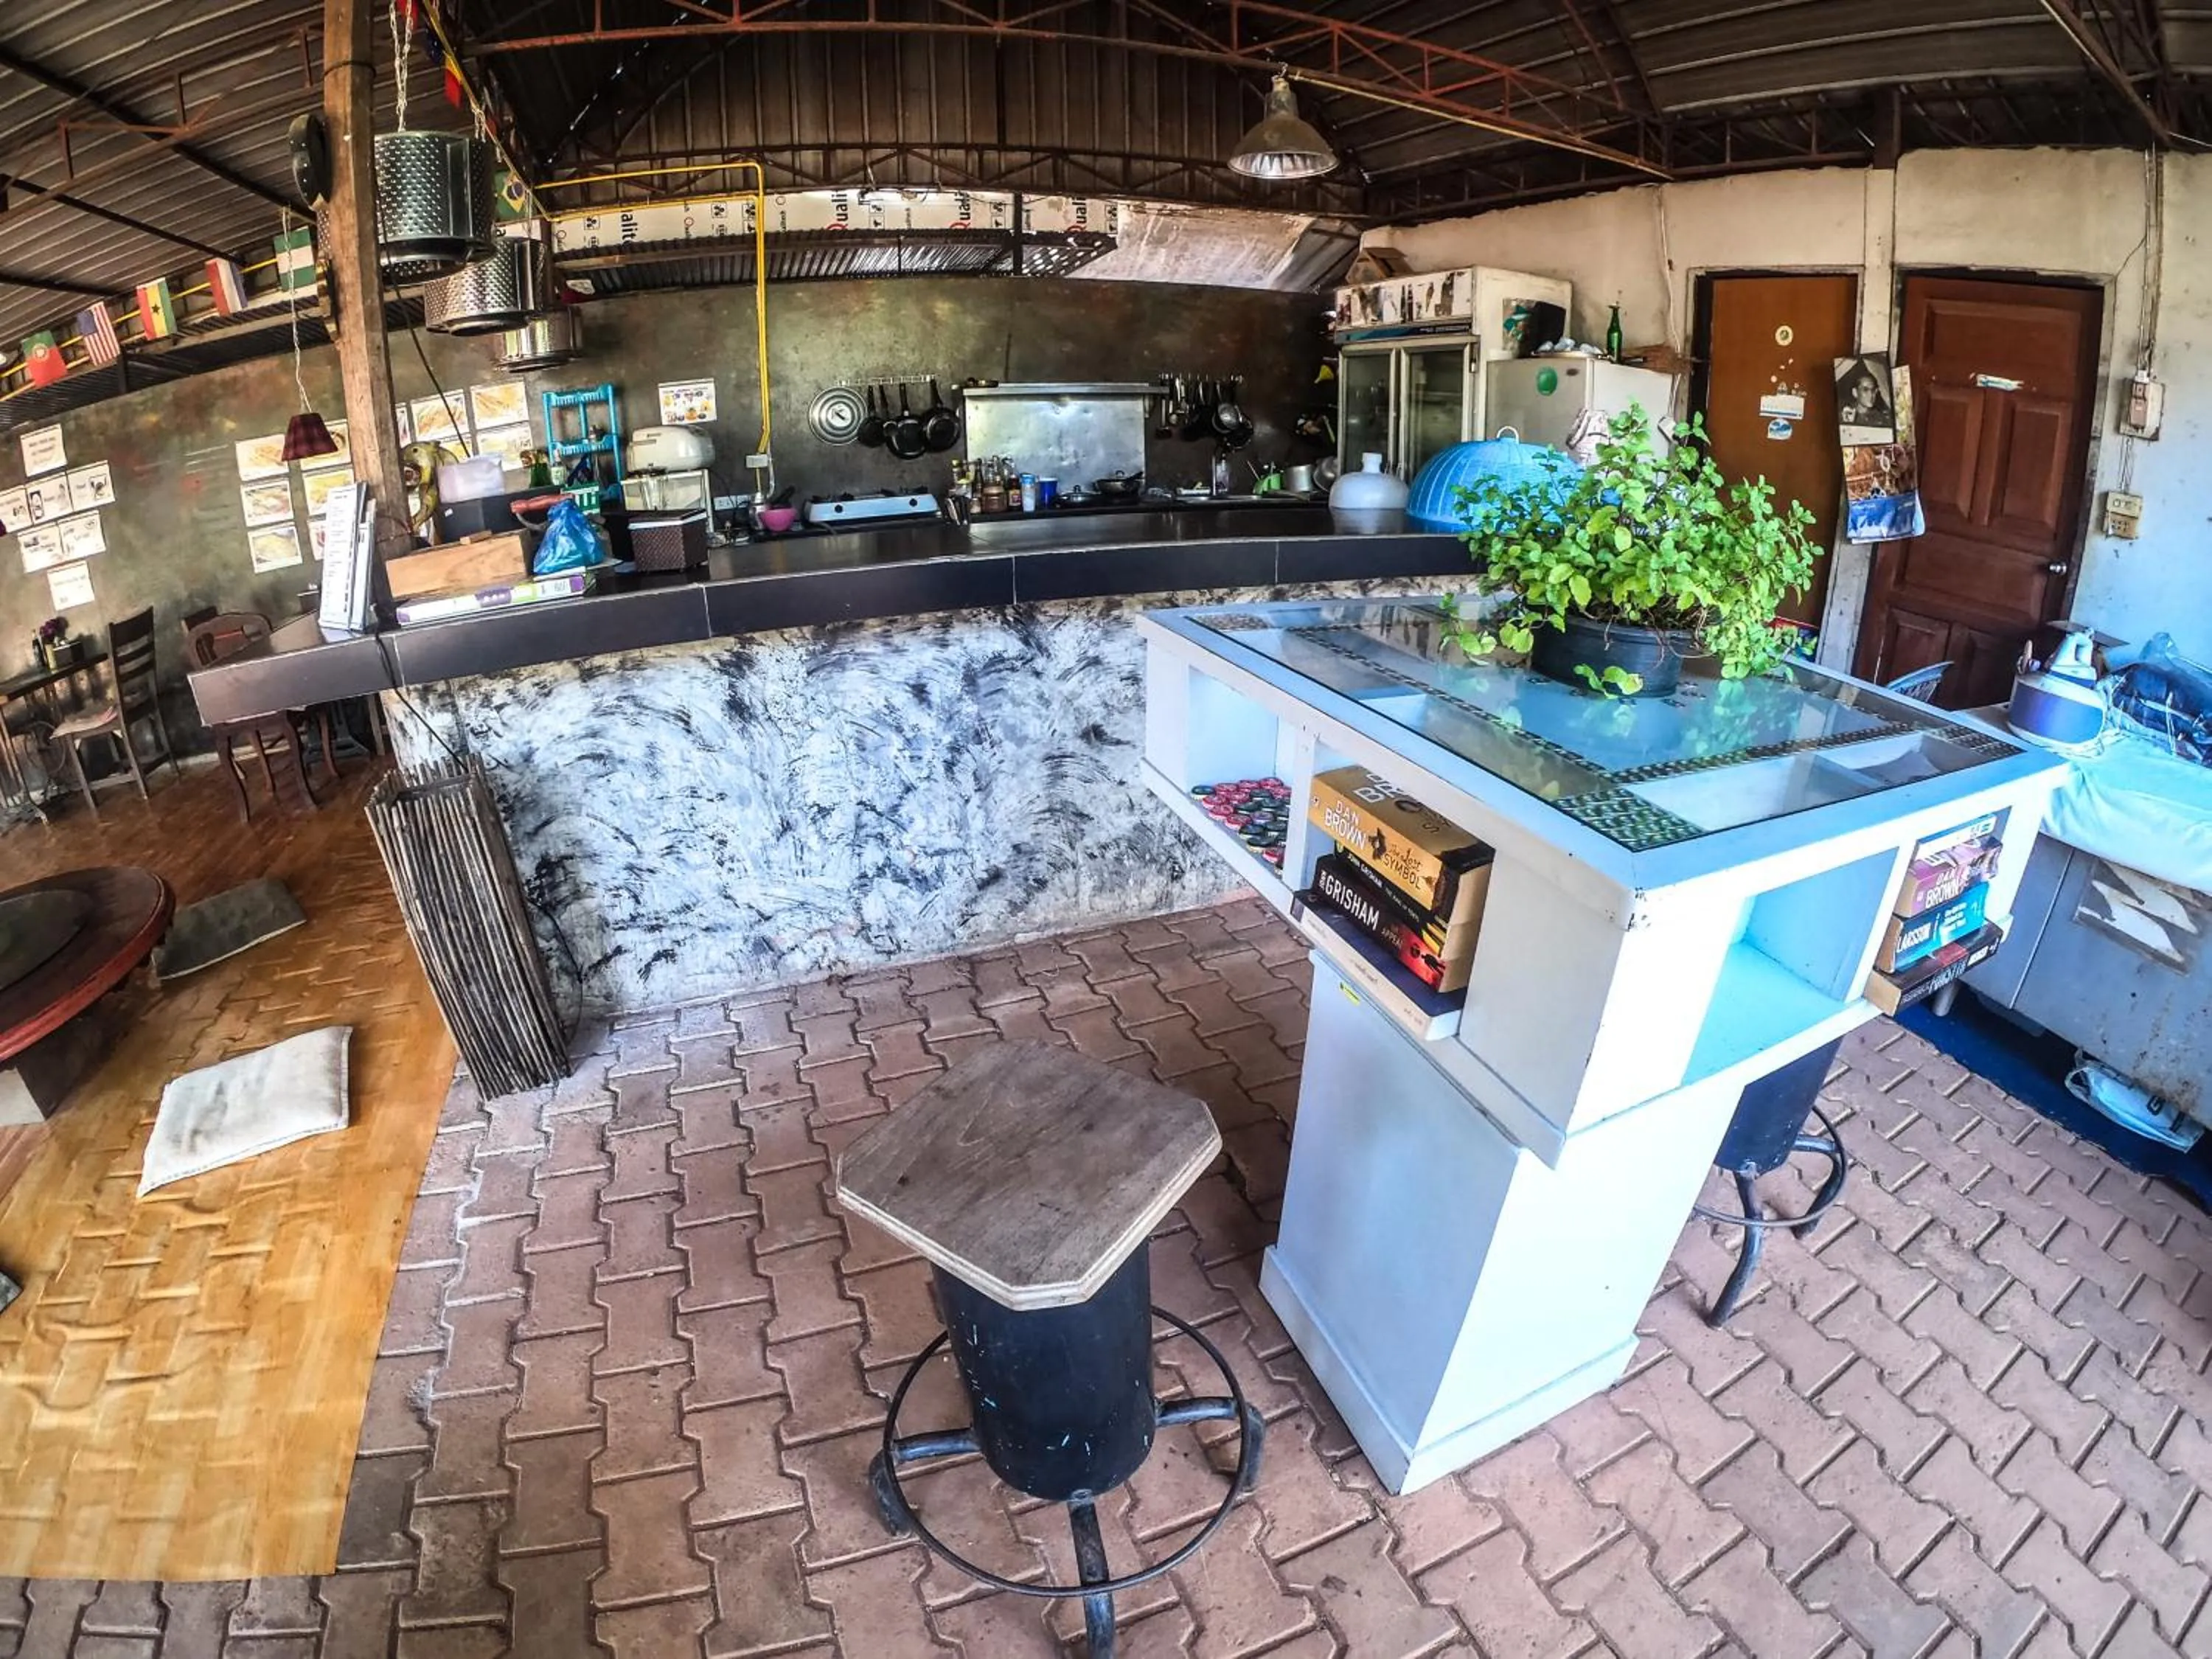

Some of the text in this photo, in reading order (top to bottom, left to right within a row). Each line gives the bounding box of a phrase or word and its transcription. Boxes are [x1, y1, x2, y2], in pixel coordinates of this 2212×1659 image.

[1324, 808, 1366, 850] BROWN
[1336, 801, 1360, 825] DAN
[1382, 853, 1422, 890] SYMBOL
[1325, 872, 1381, 931] GRISHAM
